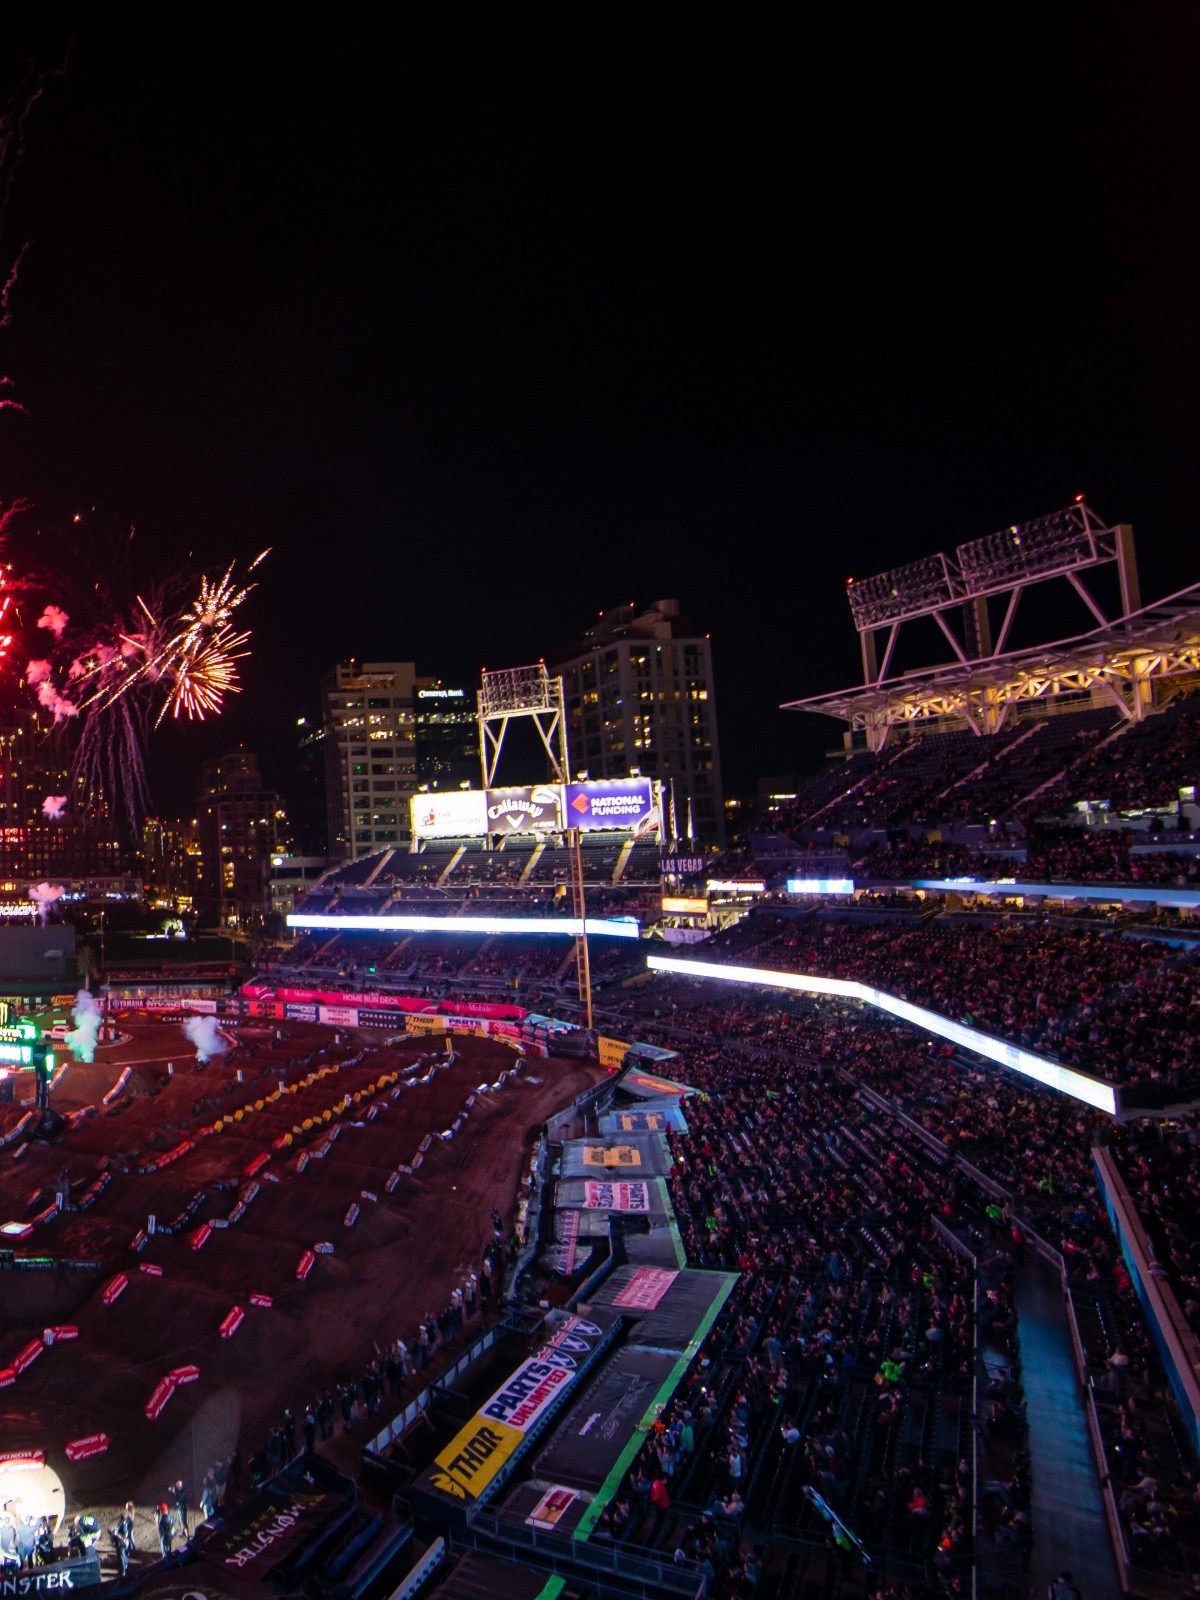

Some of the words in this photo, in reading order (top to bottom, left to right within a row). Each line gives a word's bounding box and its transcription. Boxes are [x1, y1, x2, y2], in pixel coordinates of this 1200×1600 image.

[590, 794, 645, 807] NATIONAL
[488, 799, 544, 820] Callaway
[591, 804, 641, 816] FUNDING
[661, 859, 676, 872] LAS
[677, 858, 703, 872] VEGAS
[342, 993, 363, 1002] HOME
[363, 995, 379, 1003] RUN
[379, 996, 399, 1006] DECK
[448, 1018, 482, 1026] PARTS
[484, 1361, 552, 1422] PARTS
[508, 1369, 568, 1427] UNLIMITED
[448, 1426, 504, 1481] THOR
[225, 1503, 306, 1568] MONSTER
